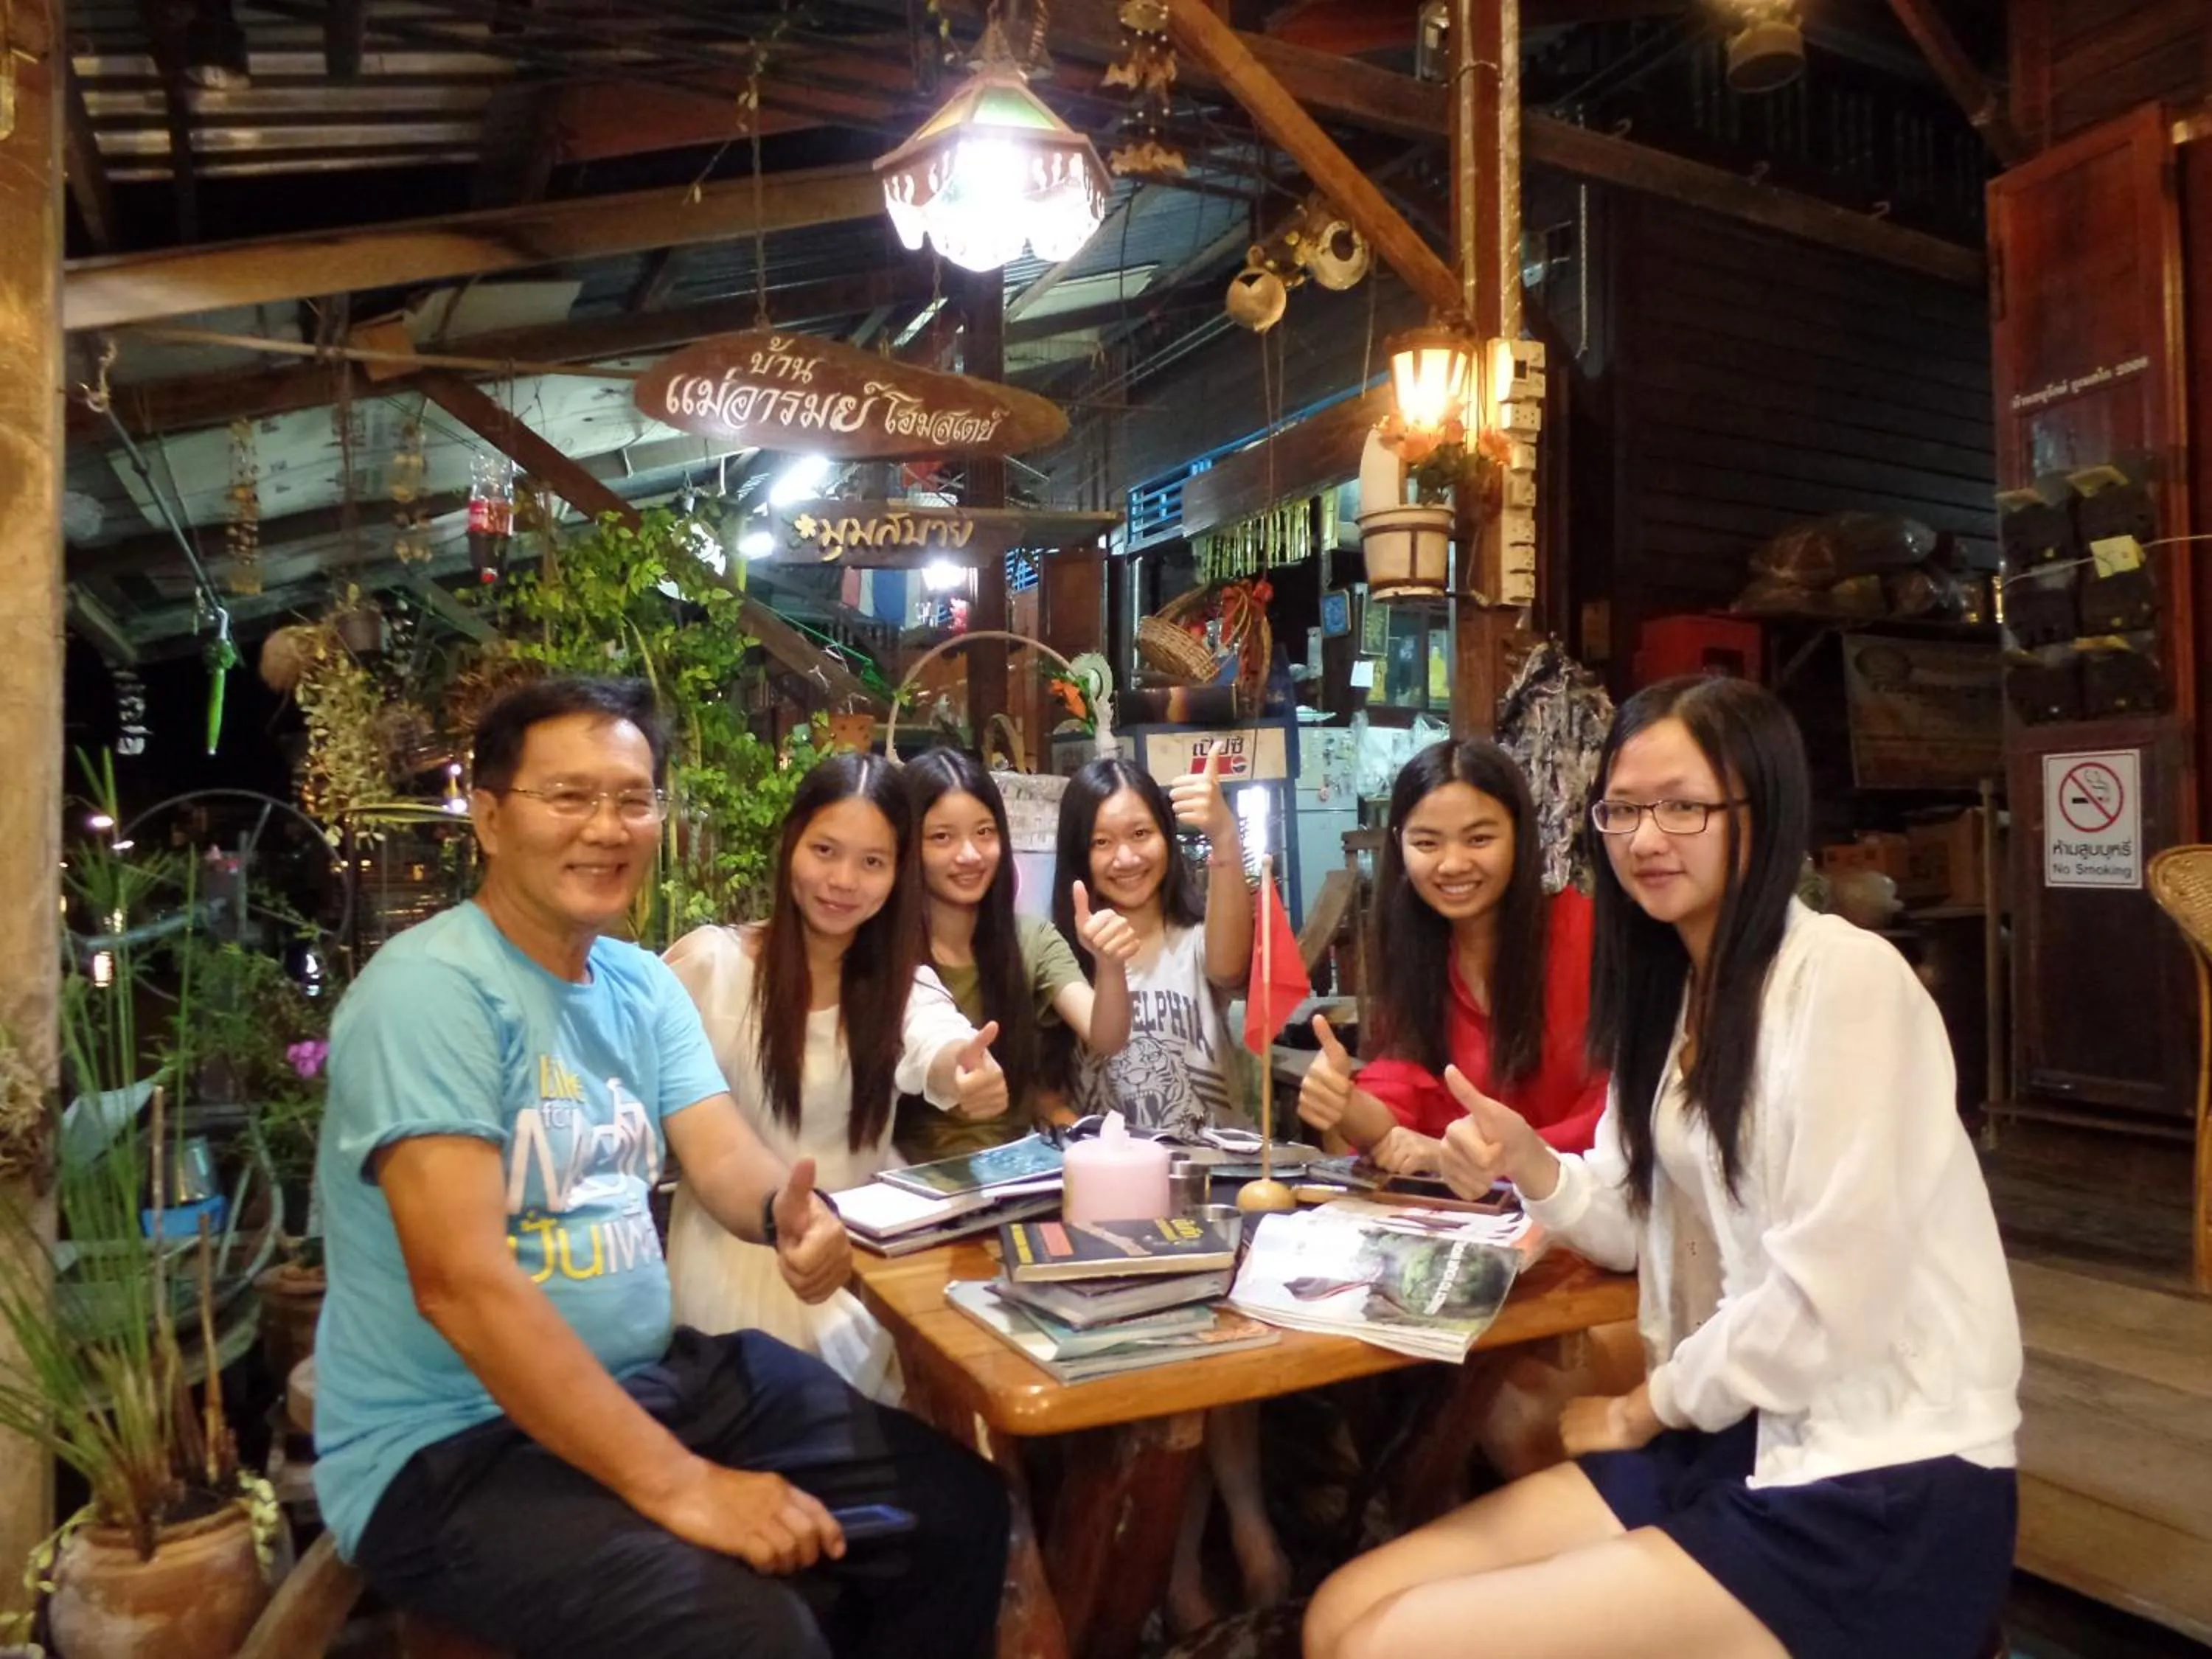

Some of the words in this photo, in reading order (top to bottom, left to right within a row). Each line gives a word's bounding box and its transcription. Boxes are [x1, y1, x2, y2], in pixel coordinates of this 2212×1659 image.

[751, 337, 825, 383] บ้าน
[665, 366, 894, 432] แม่อารมย์
[883, 390, 1011, 445] โฮมสเตย์
[818, 512, 974, 563] มุมสบาย
[2053, 863, 2070, 875] No
[2076, 863, 2132, 879] Smoking
[1129, 990, 1215, 1062] ELPHIA
